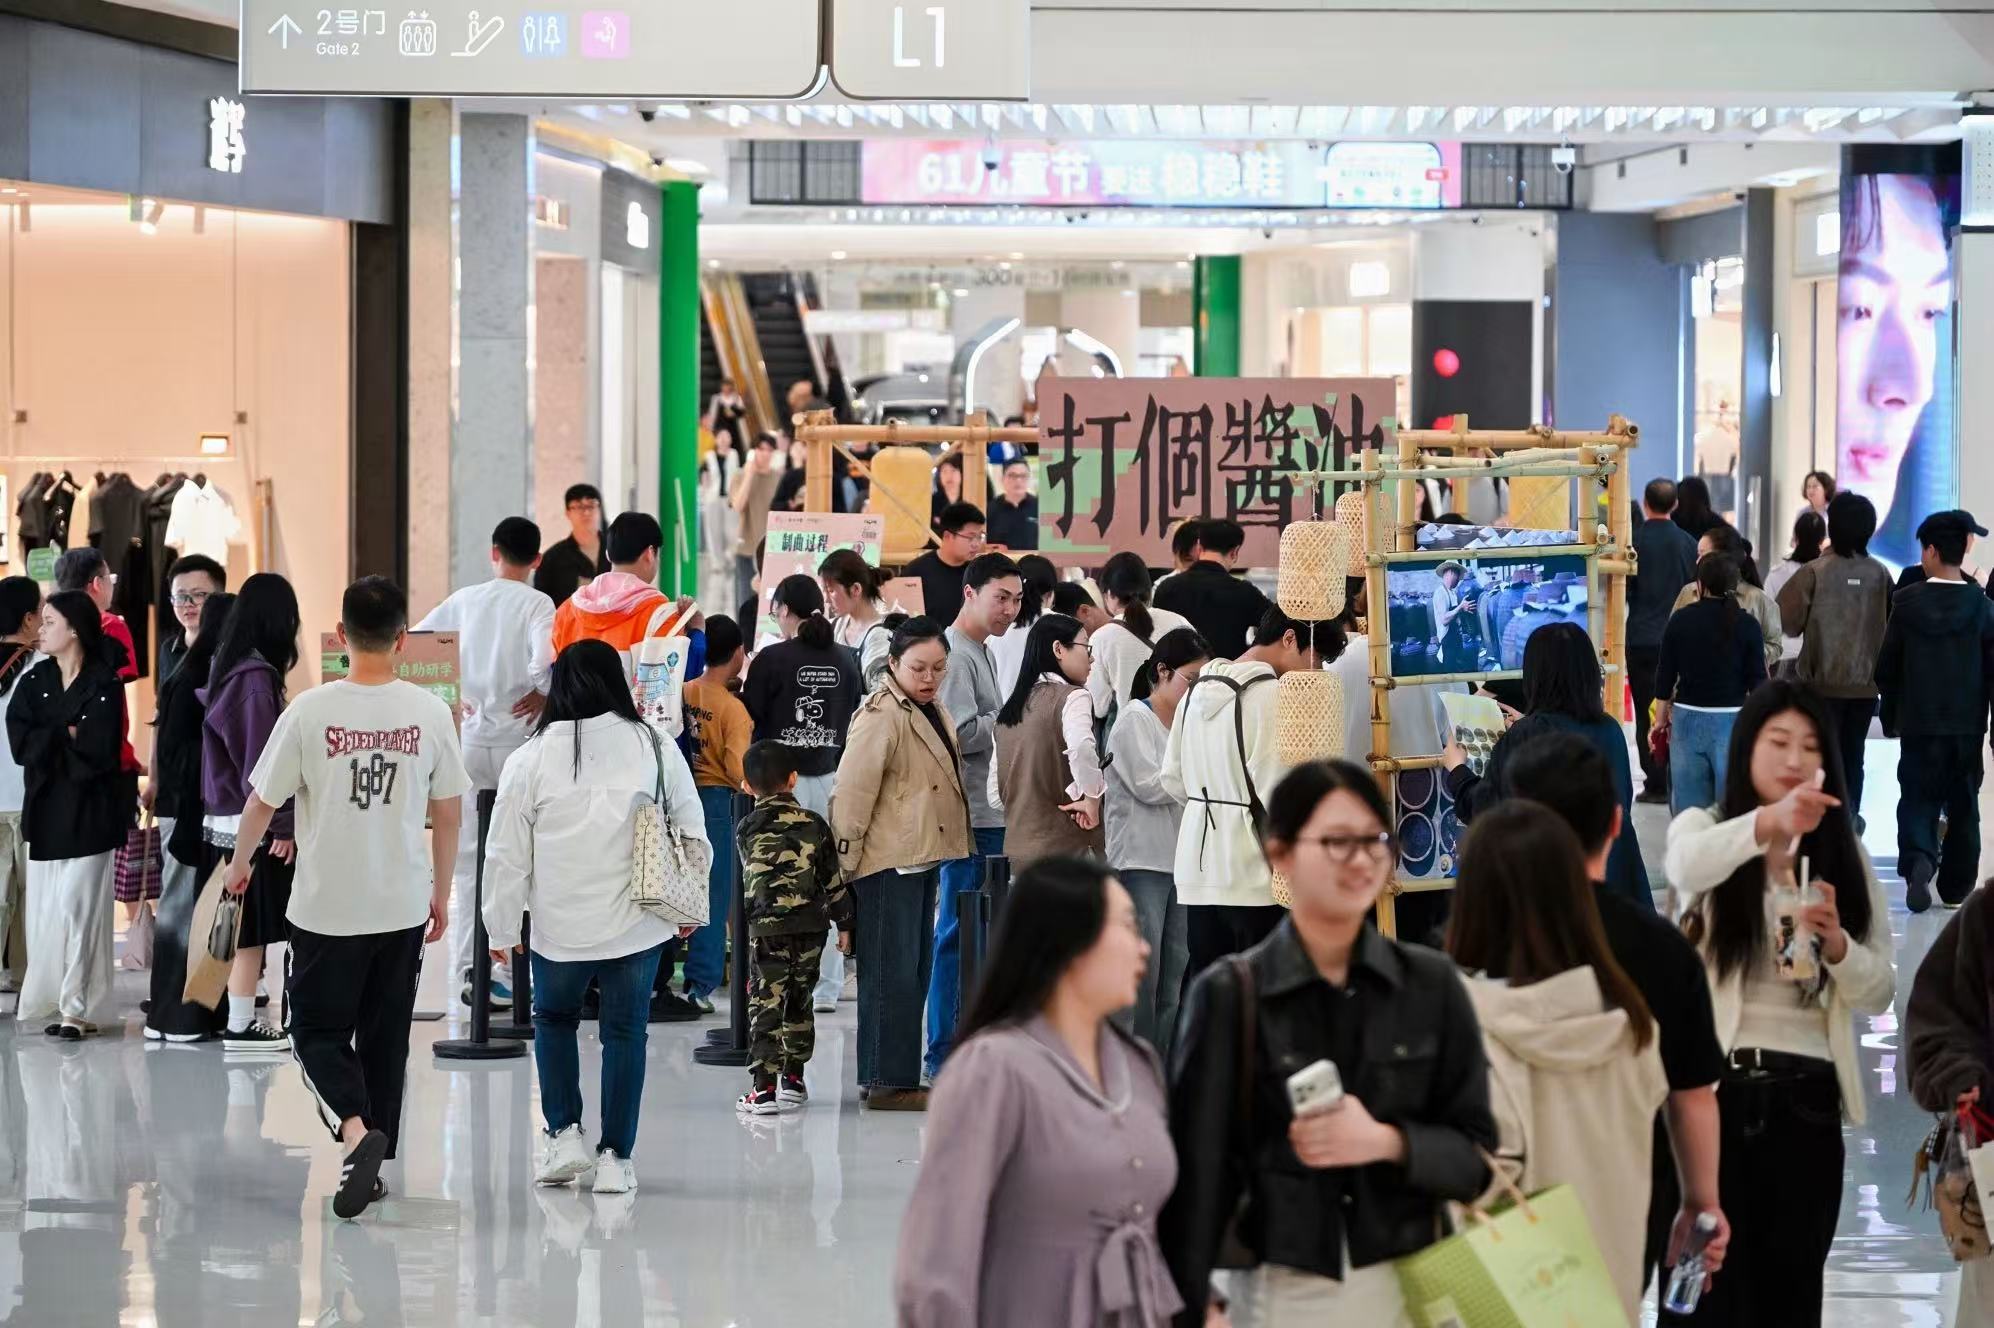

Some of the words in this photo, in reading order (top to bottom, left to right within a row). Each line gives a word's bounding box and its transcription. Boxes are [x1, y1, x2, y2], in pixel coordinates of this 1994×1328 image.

[317, 9, 385, 35] 2号门
[894, 6, 944, 68] L1
[316, 42, 348, 55] Gate
[352, 42, 360, 55] 2
[918, 151, 1090, 197] 61儿童节
[781, 532, 829, 552] 制曲过程
[392, 662, 453, 677] 自助研学
[325, 726, 375, 760] SEEDED
[375, 725, 420, 757] PLAYER
[350, 753, 398, 810] 1987
